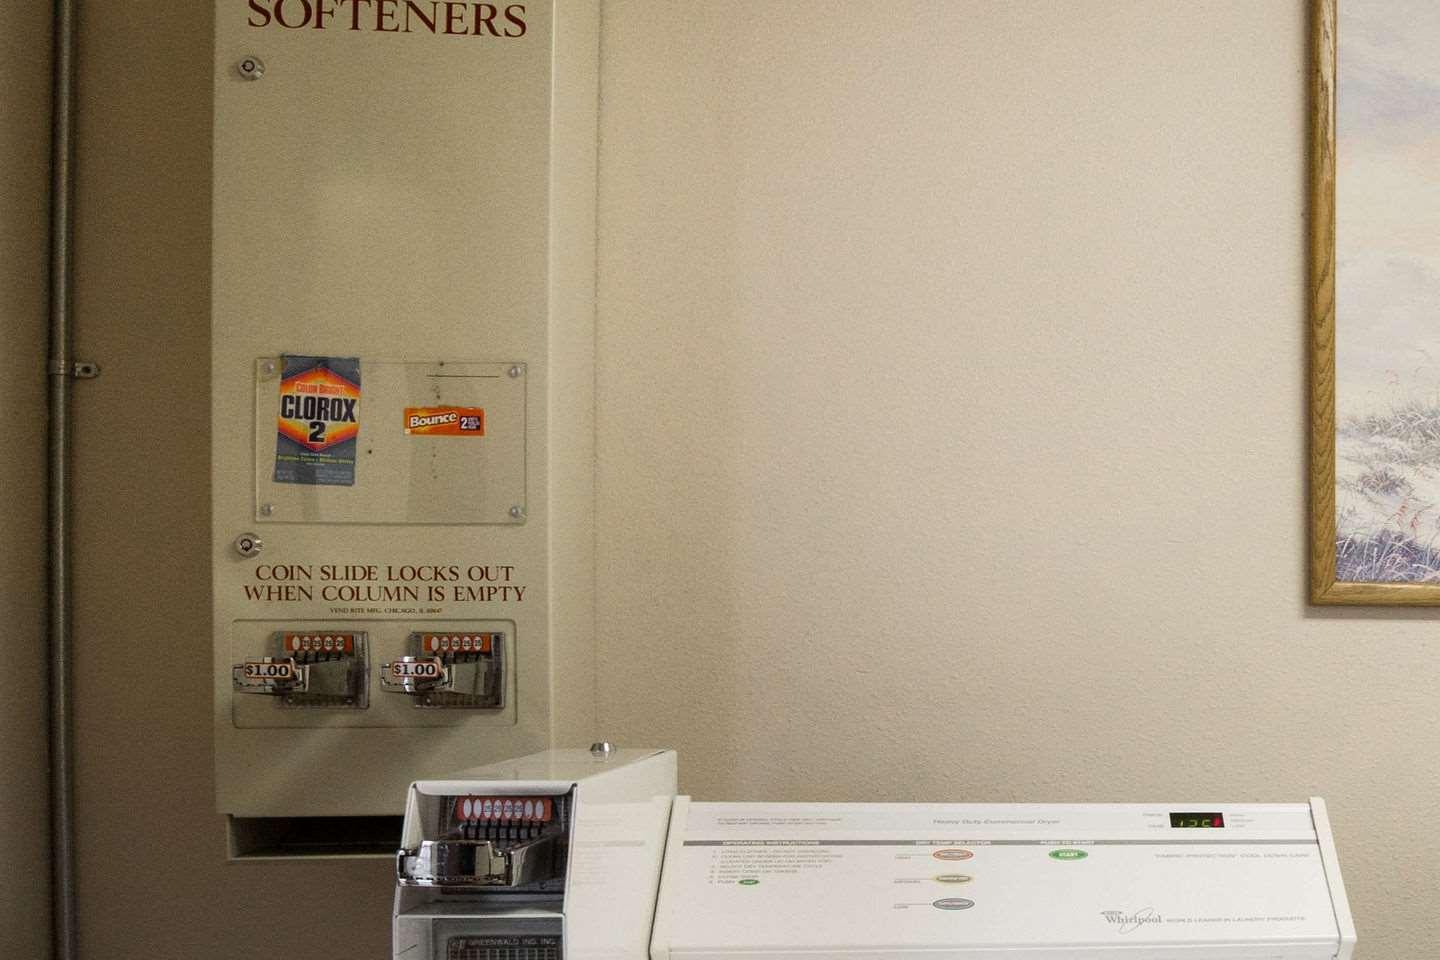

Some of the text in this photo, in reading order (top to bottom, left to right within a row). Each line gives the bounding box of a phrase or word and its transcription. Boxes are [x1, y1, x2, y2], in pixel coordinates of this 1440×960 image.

[247, 0, 528, 38] SOFTENERS
[281, 394, 358, 423] CLOROX
[409, 412, 458, 428] Bounce
[308, 421, 326, 442] 2
[255, 564, 515, 582] COIN SLIDE LOCKS OUT
[244, 585, 527, 602] WHEN COLUMN IS EMPTY
[245, 664, 290, 677] $1.00
[392, 663, 436, 676] $1.00
